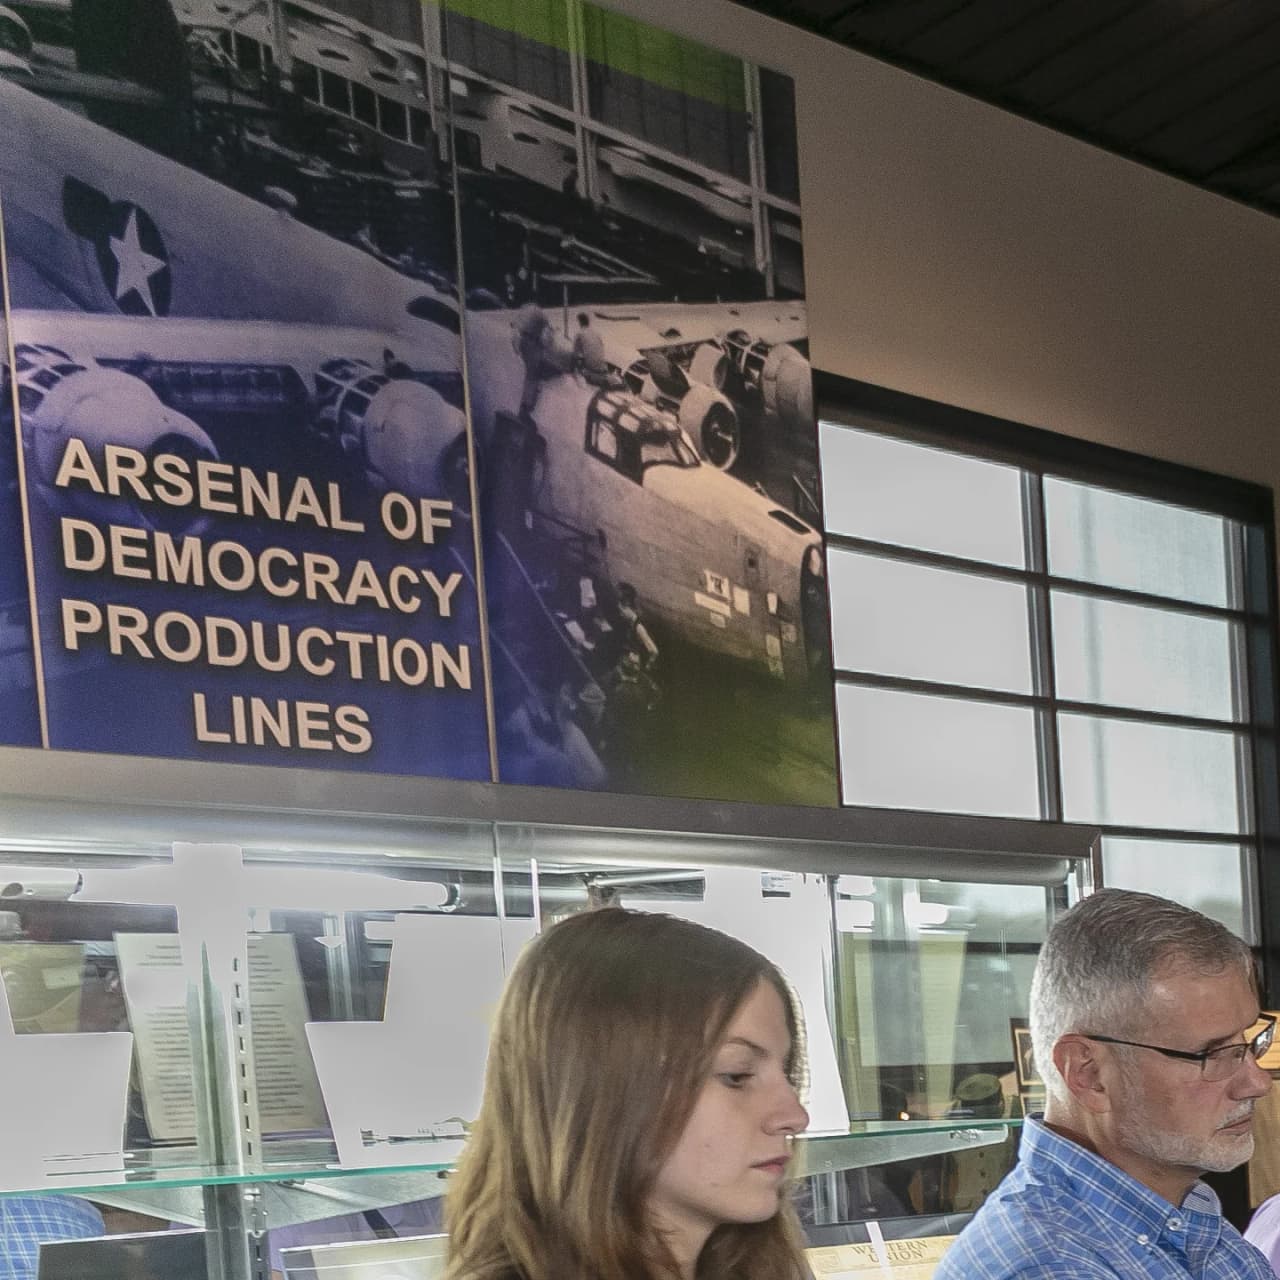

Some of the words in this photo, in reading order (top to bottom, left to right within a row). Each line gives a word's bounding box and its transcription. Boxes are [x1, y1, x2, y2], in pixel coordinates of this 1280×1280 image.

[55, 437, 365, 533] ARSENAL
[381, 491, 453, 544] OF
[60, 516, 463, 617] DEMOCRACY
[61, 598, 472, 690] PRODUCTION
[193, 692, 373, 754] LINES
[851, 1239, 929, 1255] WETERN
